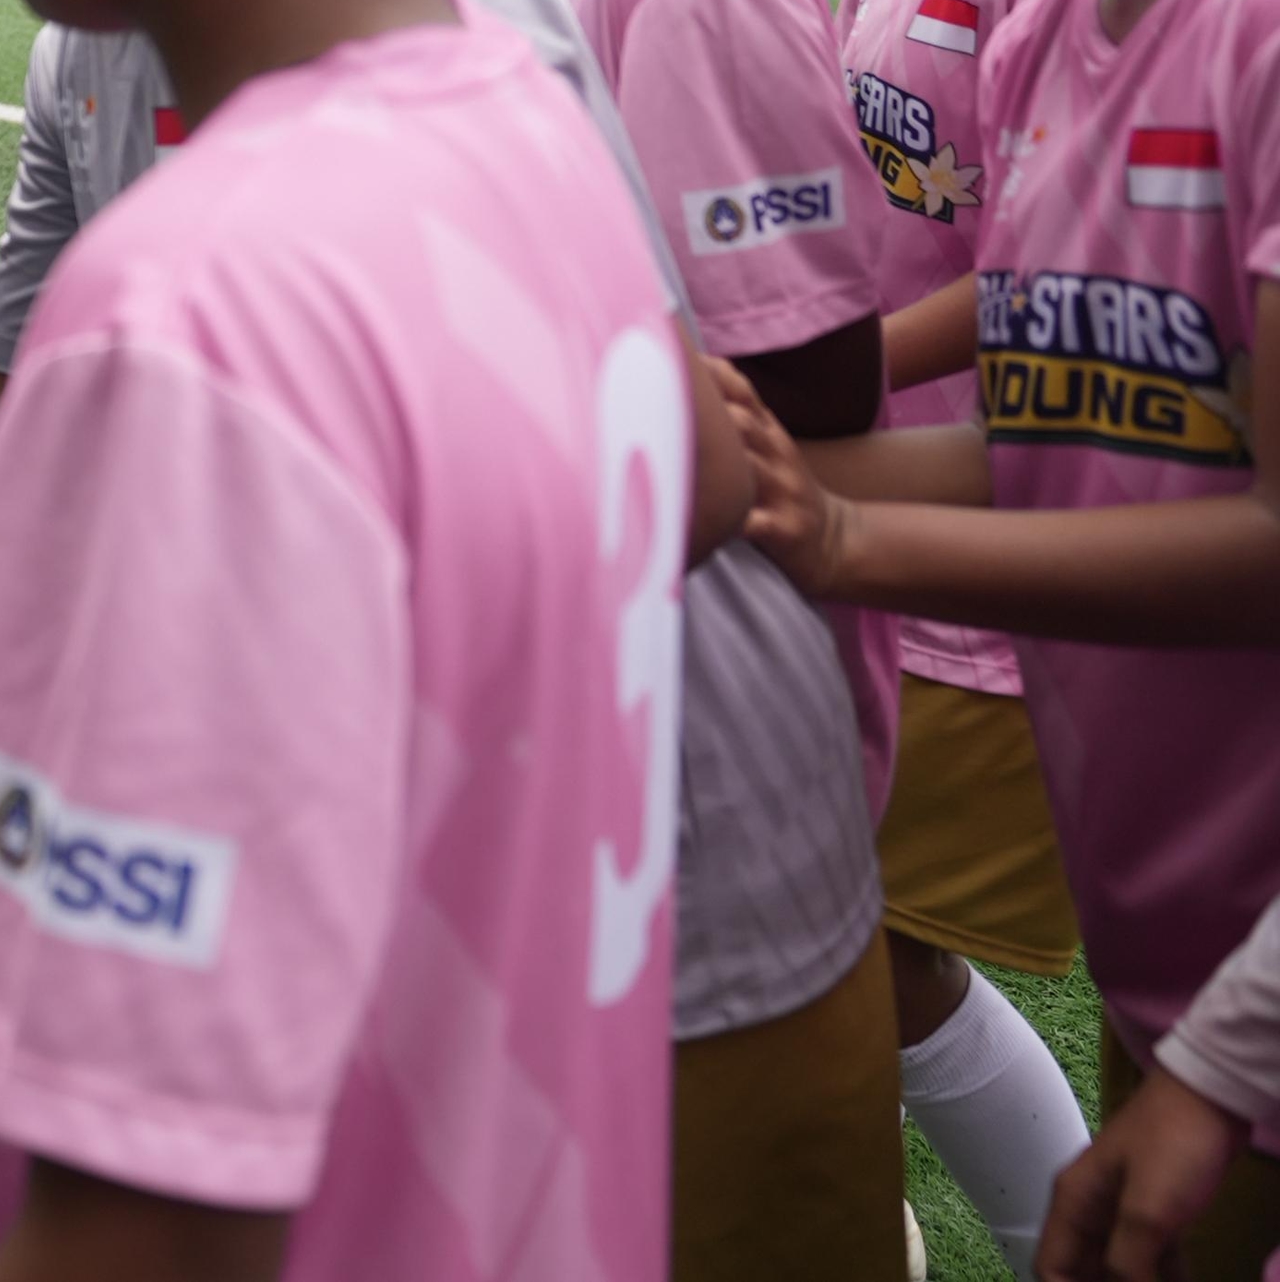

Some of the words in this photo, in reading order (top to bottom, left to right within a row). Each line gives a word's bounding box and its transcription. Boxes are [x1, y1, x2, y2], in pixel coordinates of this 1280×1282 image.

[858, 72, 931, 153] SARS
[750, 180, 832, 234] PSSI
[1027, 276, 1220, 374] STARS
[587, 327, 690, 1006] 3
